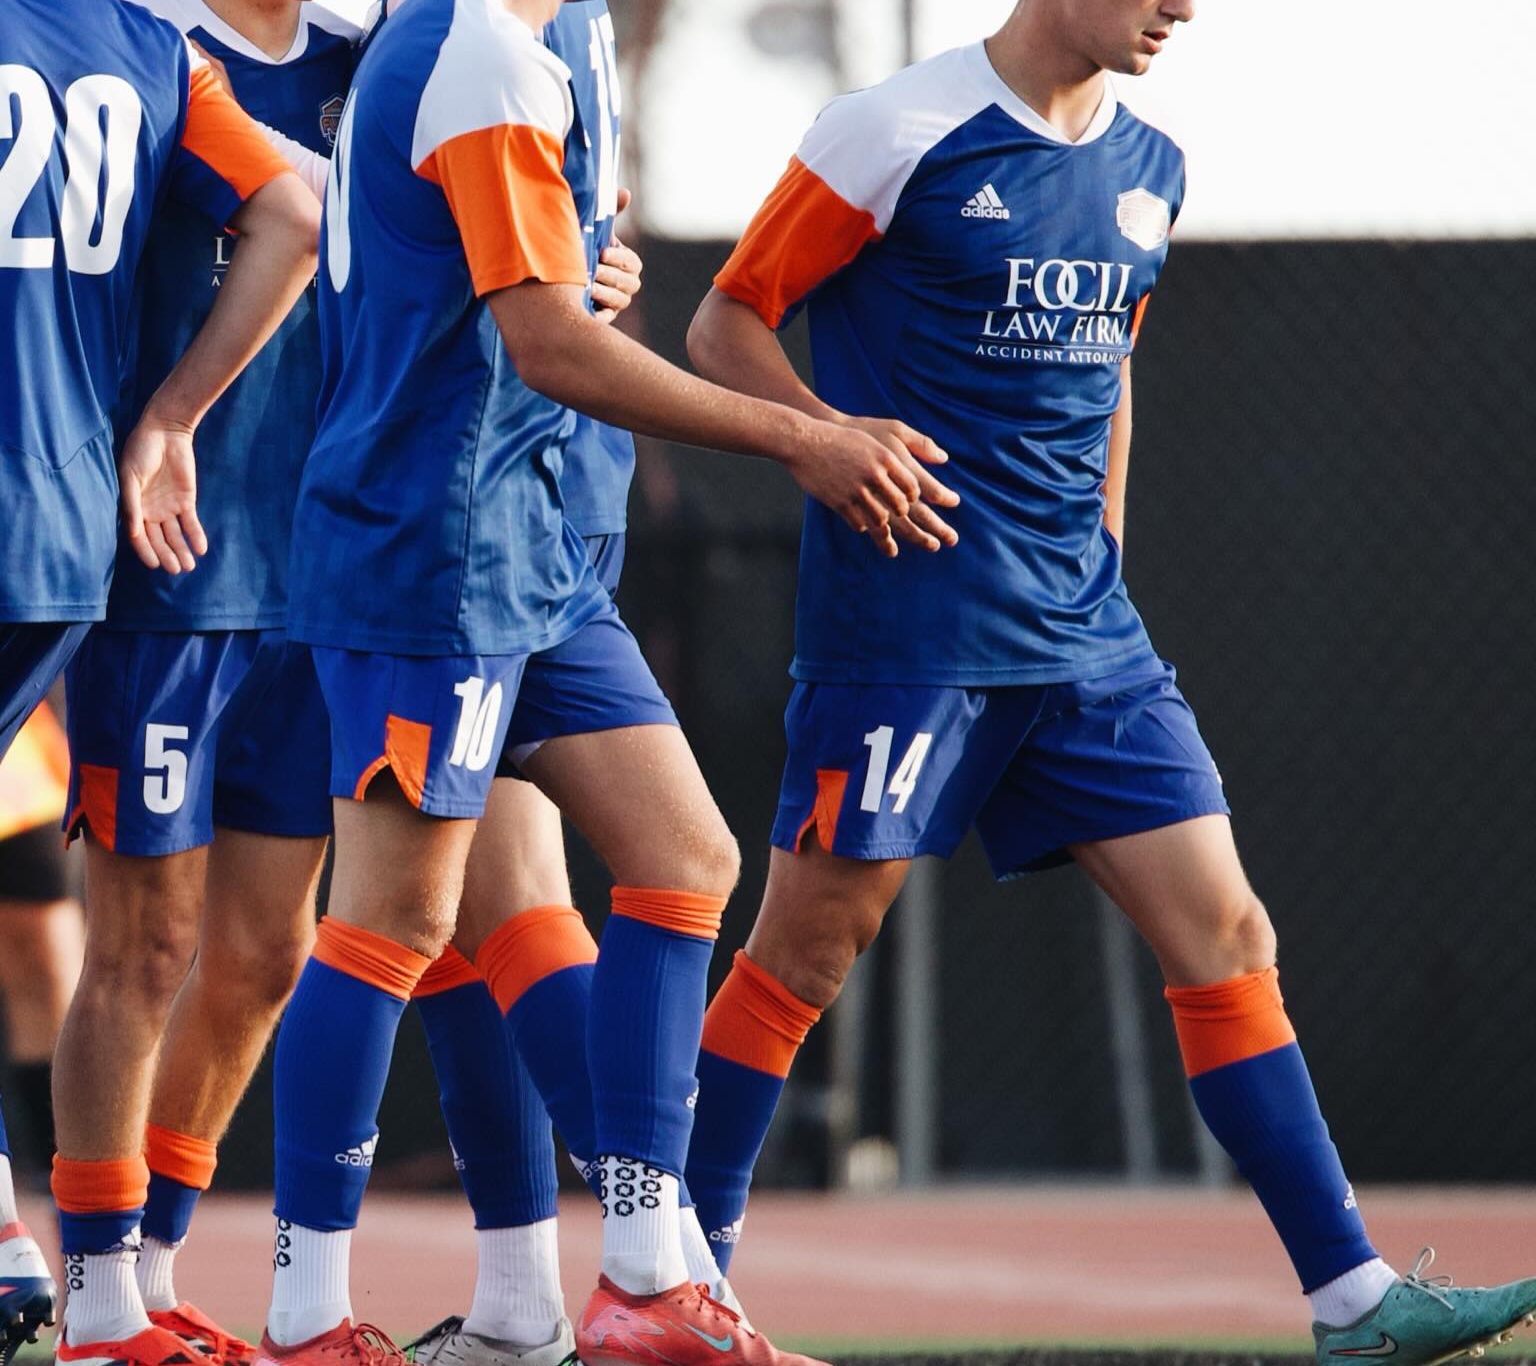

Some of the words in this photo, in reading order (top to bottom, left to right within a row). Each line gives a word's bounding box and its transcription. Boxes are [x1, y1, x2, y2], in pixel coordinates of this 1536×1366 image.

[960, 205, 1010, 220] adidas
[1001, 258, 1134, 313] FOCIL
[975, 344, 1064, 363] ACCIDENT
[981, 310, 1063, 342] LAW
[448, 675, 503, 772] 10
[142, 722, 189, 815] 5
[860, 724, 933, 814] 14
